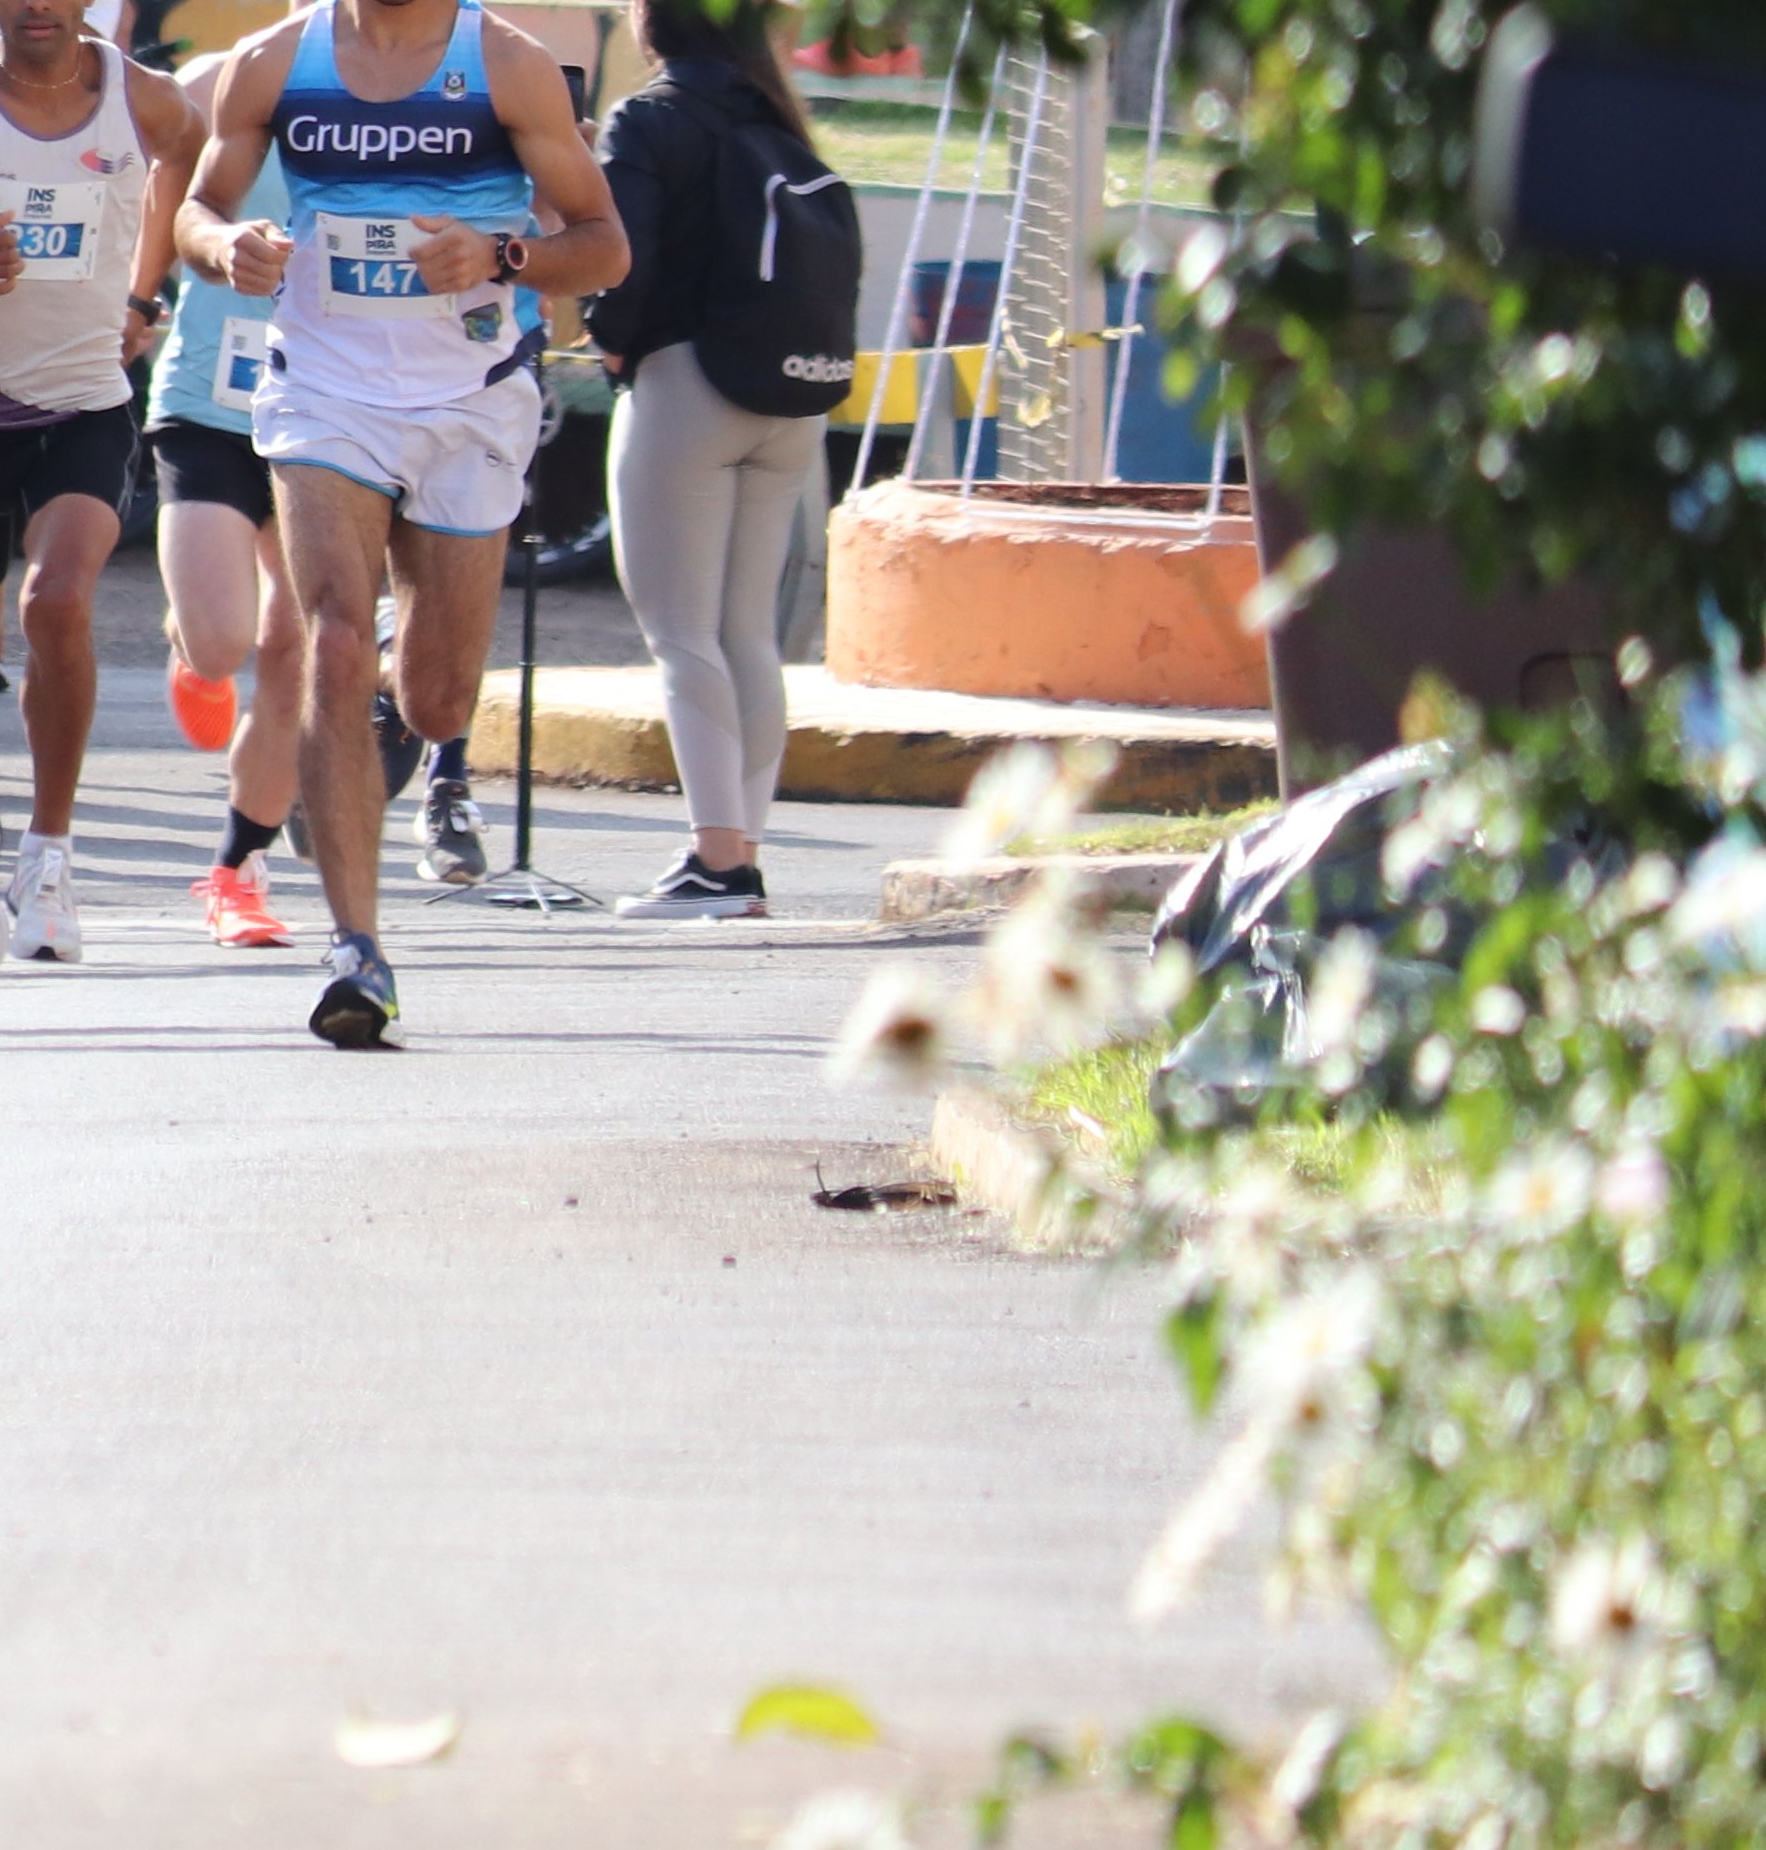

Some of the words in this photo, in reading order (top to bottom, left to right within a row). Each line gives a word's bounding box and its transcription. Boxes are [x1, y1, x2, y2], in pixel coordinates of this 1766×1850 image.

[287, 115, 473, 162] Gruppen
[27, 187, 56, 203] INS
[365, 223, 396, 238] INS
[349, 260, 418, 294] 147
[782, 354, 854, 383] adidas
